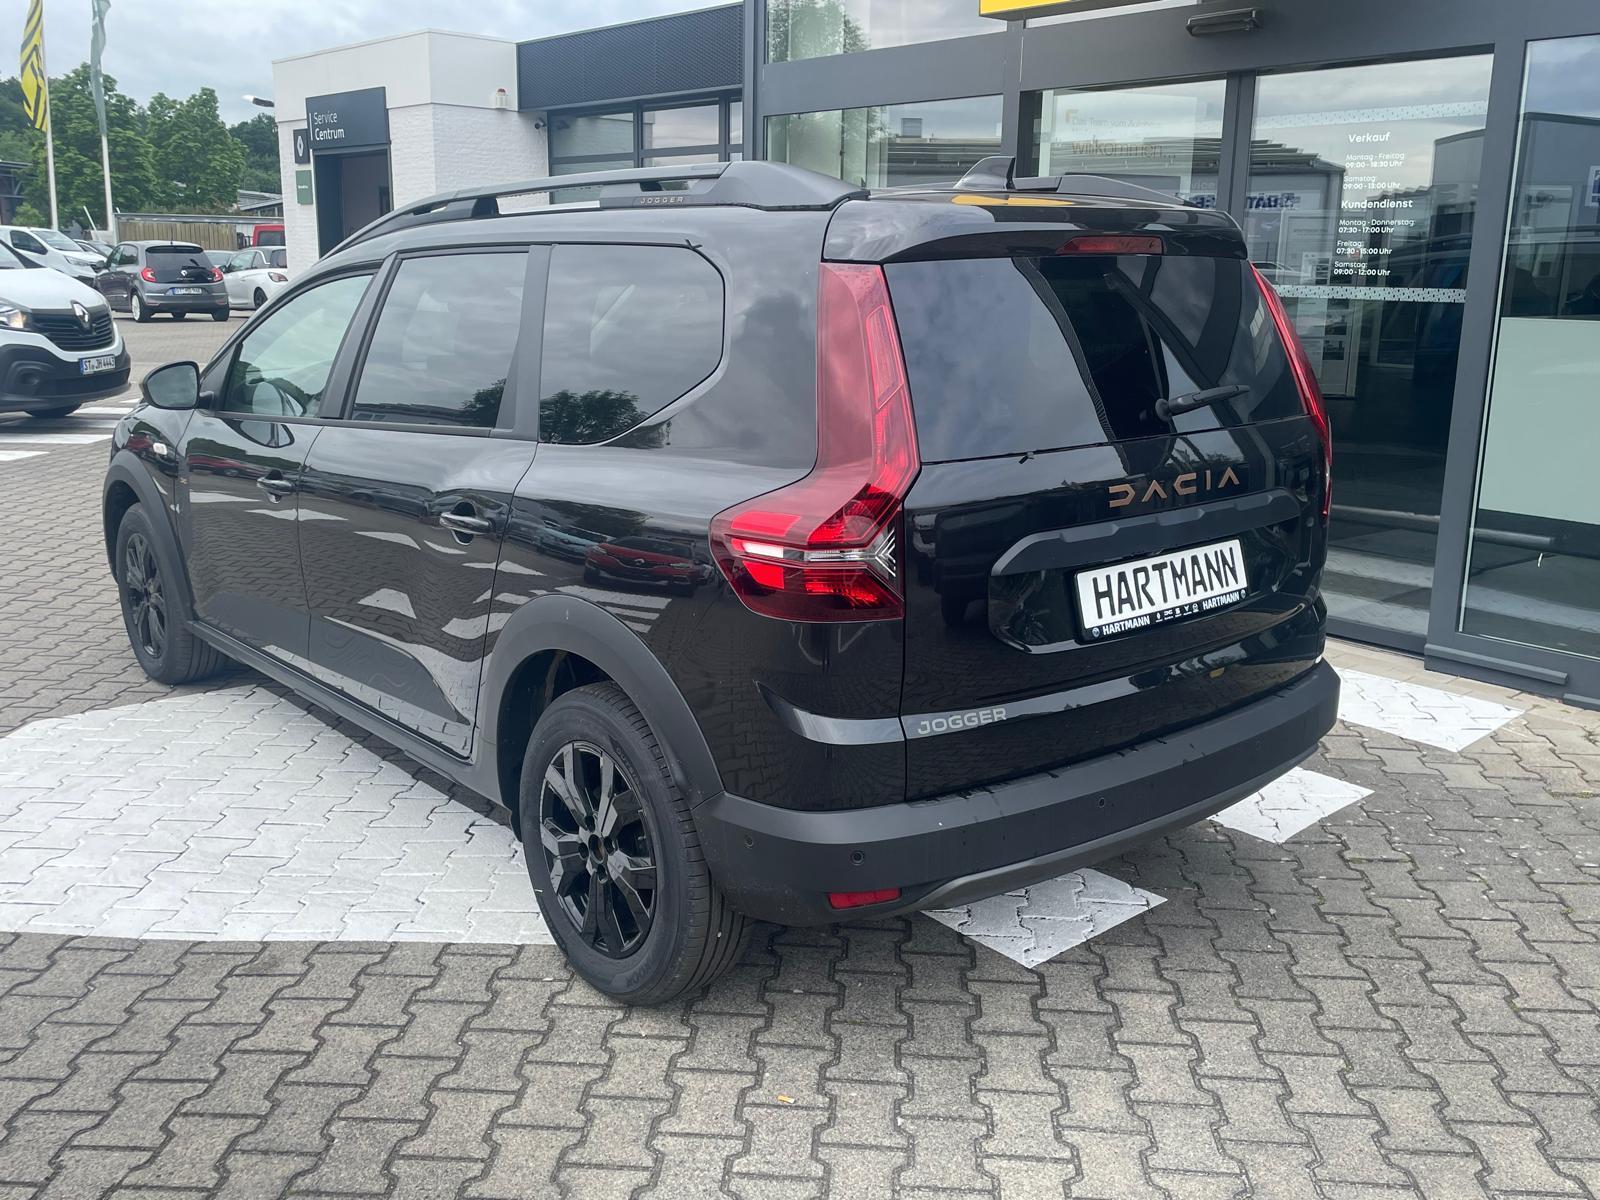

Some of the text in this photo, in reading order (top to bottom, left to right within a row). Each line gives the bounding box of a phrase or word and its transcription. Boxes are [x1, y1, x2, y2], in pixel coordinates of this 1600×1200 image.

[313, 111, 338, 125] Service
[314, 127, 345, 141] Centrum
[1348, 131, 1391, 143] Verkauf
[1345, 154, 1374, 162] Montag
[1345, 161, 1366, 169] 09:00
[1389, 160, 1403, 168] Uhr
[1387, 181, 1401, 189] Uhr
[640, 196, 684, 204] JOGGER
[1341, 199, 1414, 209] Kundendienst
[1339, 219, 1367, 227] Montag
[1362, 226, 1380, 234] 17:00
[1381, 226, 1395, 234] Uhr
[1360, 247, 1379, 255] 15:00
[1379, 247, 1393, 255] Uhr
[1358, 268, 1377, 276] 12:00
[1377, 268, 1391, 276] Uhr
[1108, 466, 1240, 508] DACIA
[1092, 547, 1239, 619] HARTMANN
[1102, 615, 1150, 636] HARTMANN
[1202, 591, 1240, 611] HARTMANN
[917, 707, 1007, 735] JOGGER
